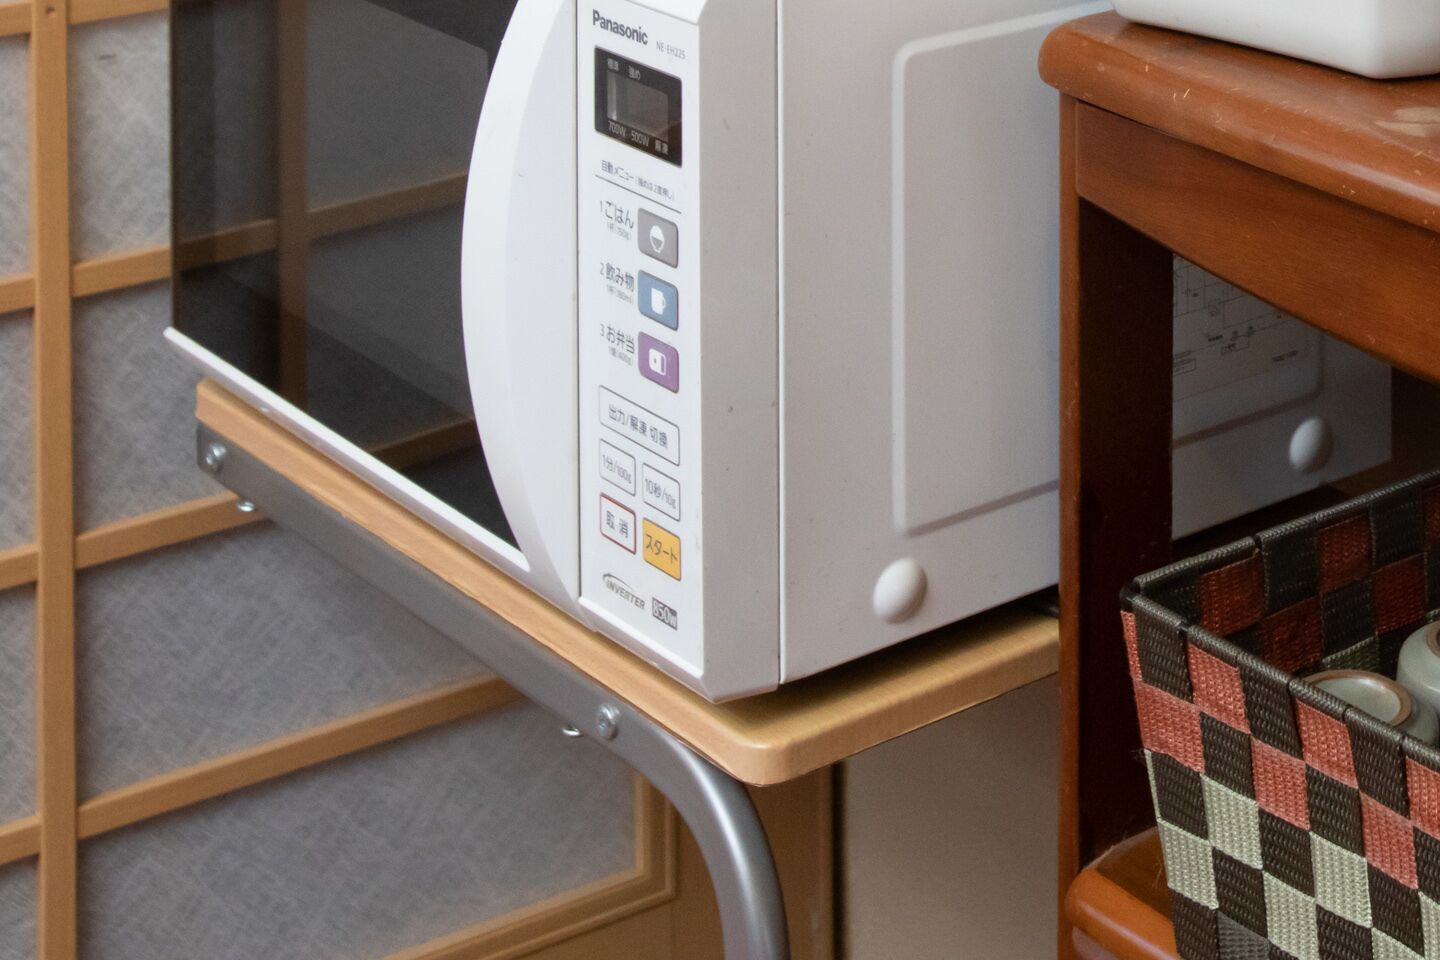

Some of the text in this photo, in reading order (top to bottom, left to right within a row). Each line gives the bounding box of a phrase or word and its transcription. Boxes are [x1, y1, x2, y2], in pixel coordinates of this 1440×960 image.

[592, 8, 648, 45] Panasonic
[605, 200, 635, 229] ごはん
[606, 324, 635, 355] お弁当
[645, 532, 678, 565] スタート
[606, 579, 646, 610] INVERTER
